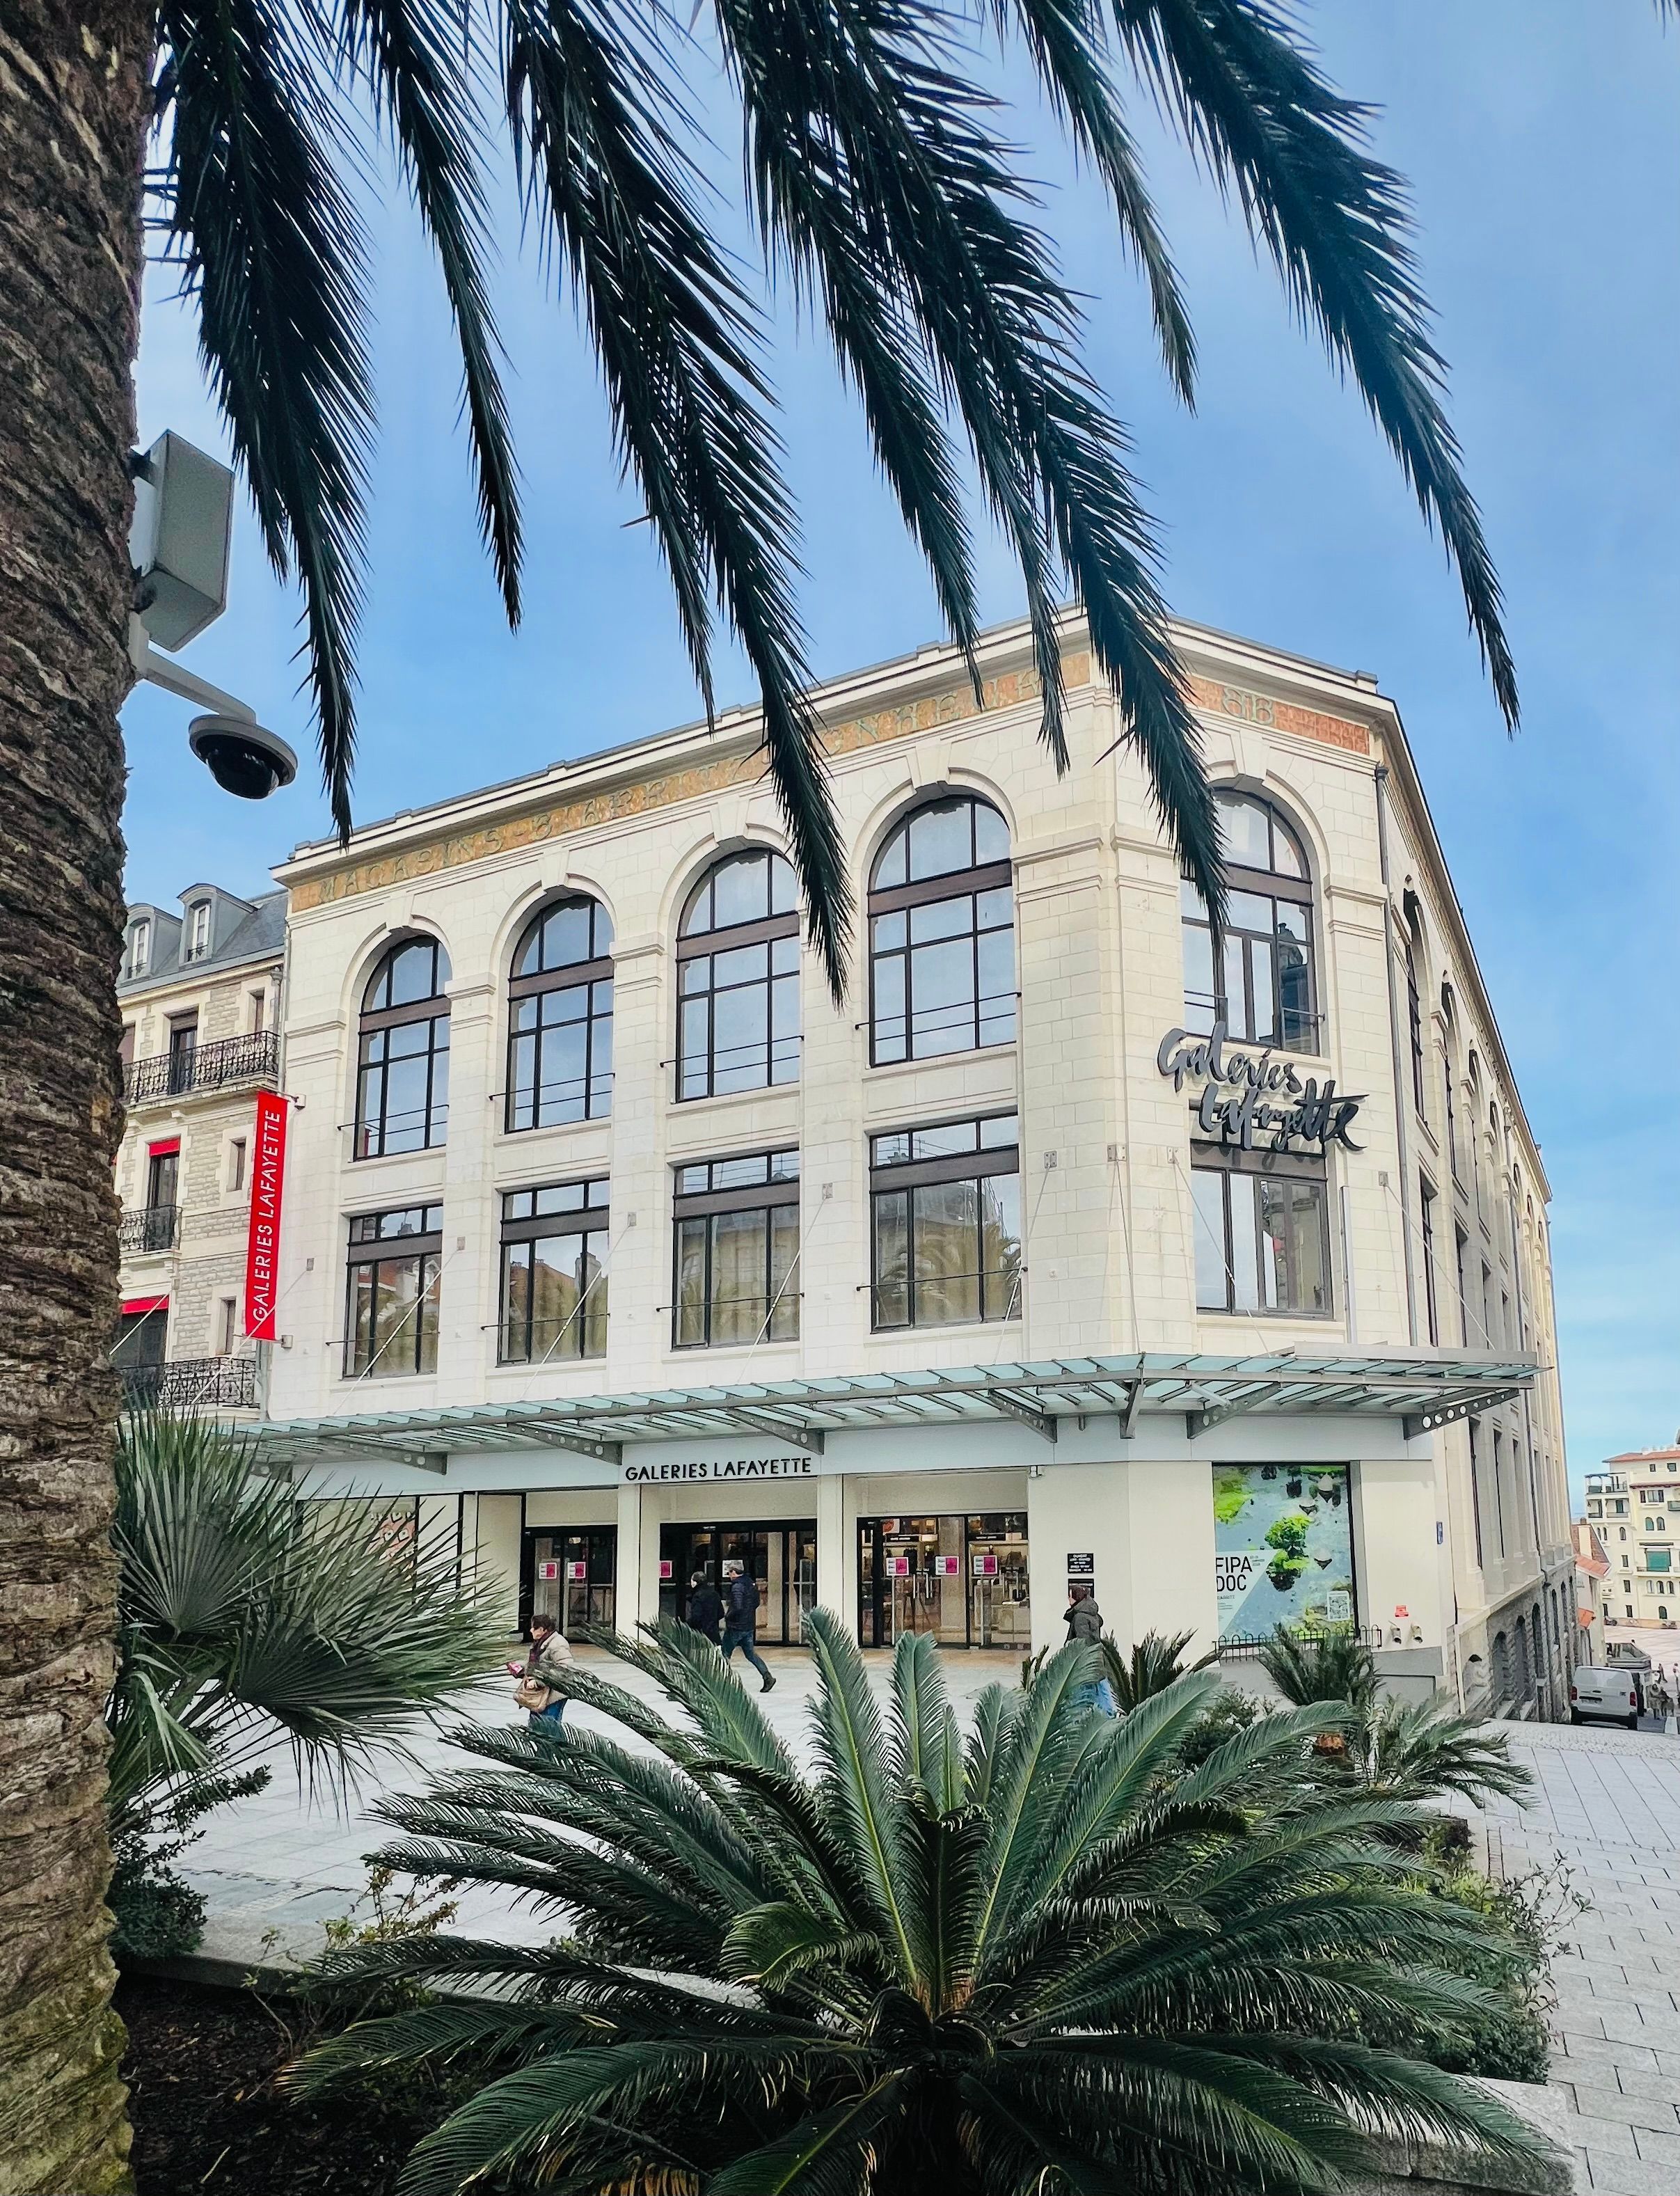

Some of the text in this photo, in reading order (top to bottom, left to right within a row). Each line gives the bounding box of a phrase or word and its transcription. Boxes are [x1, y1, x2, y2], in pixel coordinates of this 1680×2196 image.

[1157, 1020, 1303, 1093] Galeries
[1198, 1077, 1370, 1152] Lafayette
[253, 1110, 280, 1322] GALERIES LAFAYETTE
[626, 1458, 811, 1480] GALERIES LAFAYETTE
[1216, 1556, 1253, 1573] FIPA
[1217, 1574, 1246, 1592] DOC
